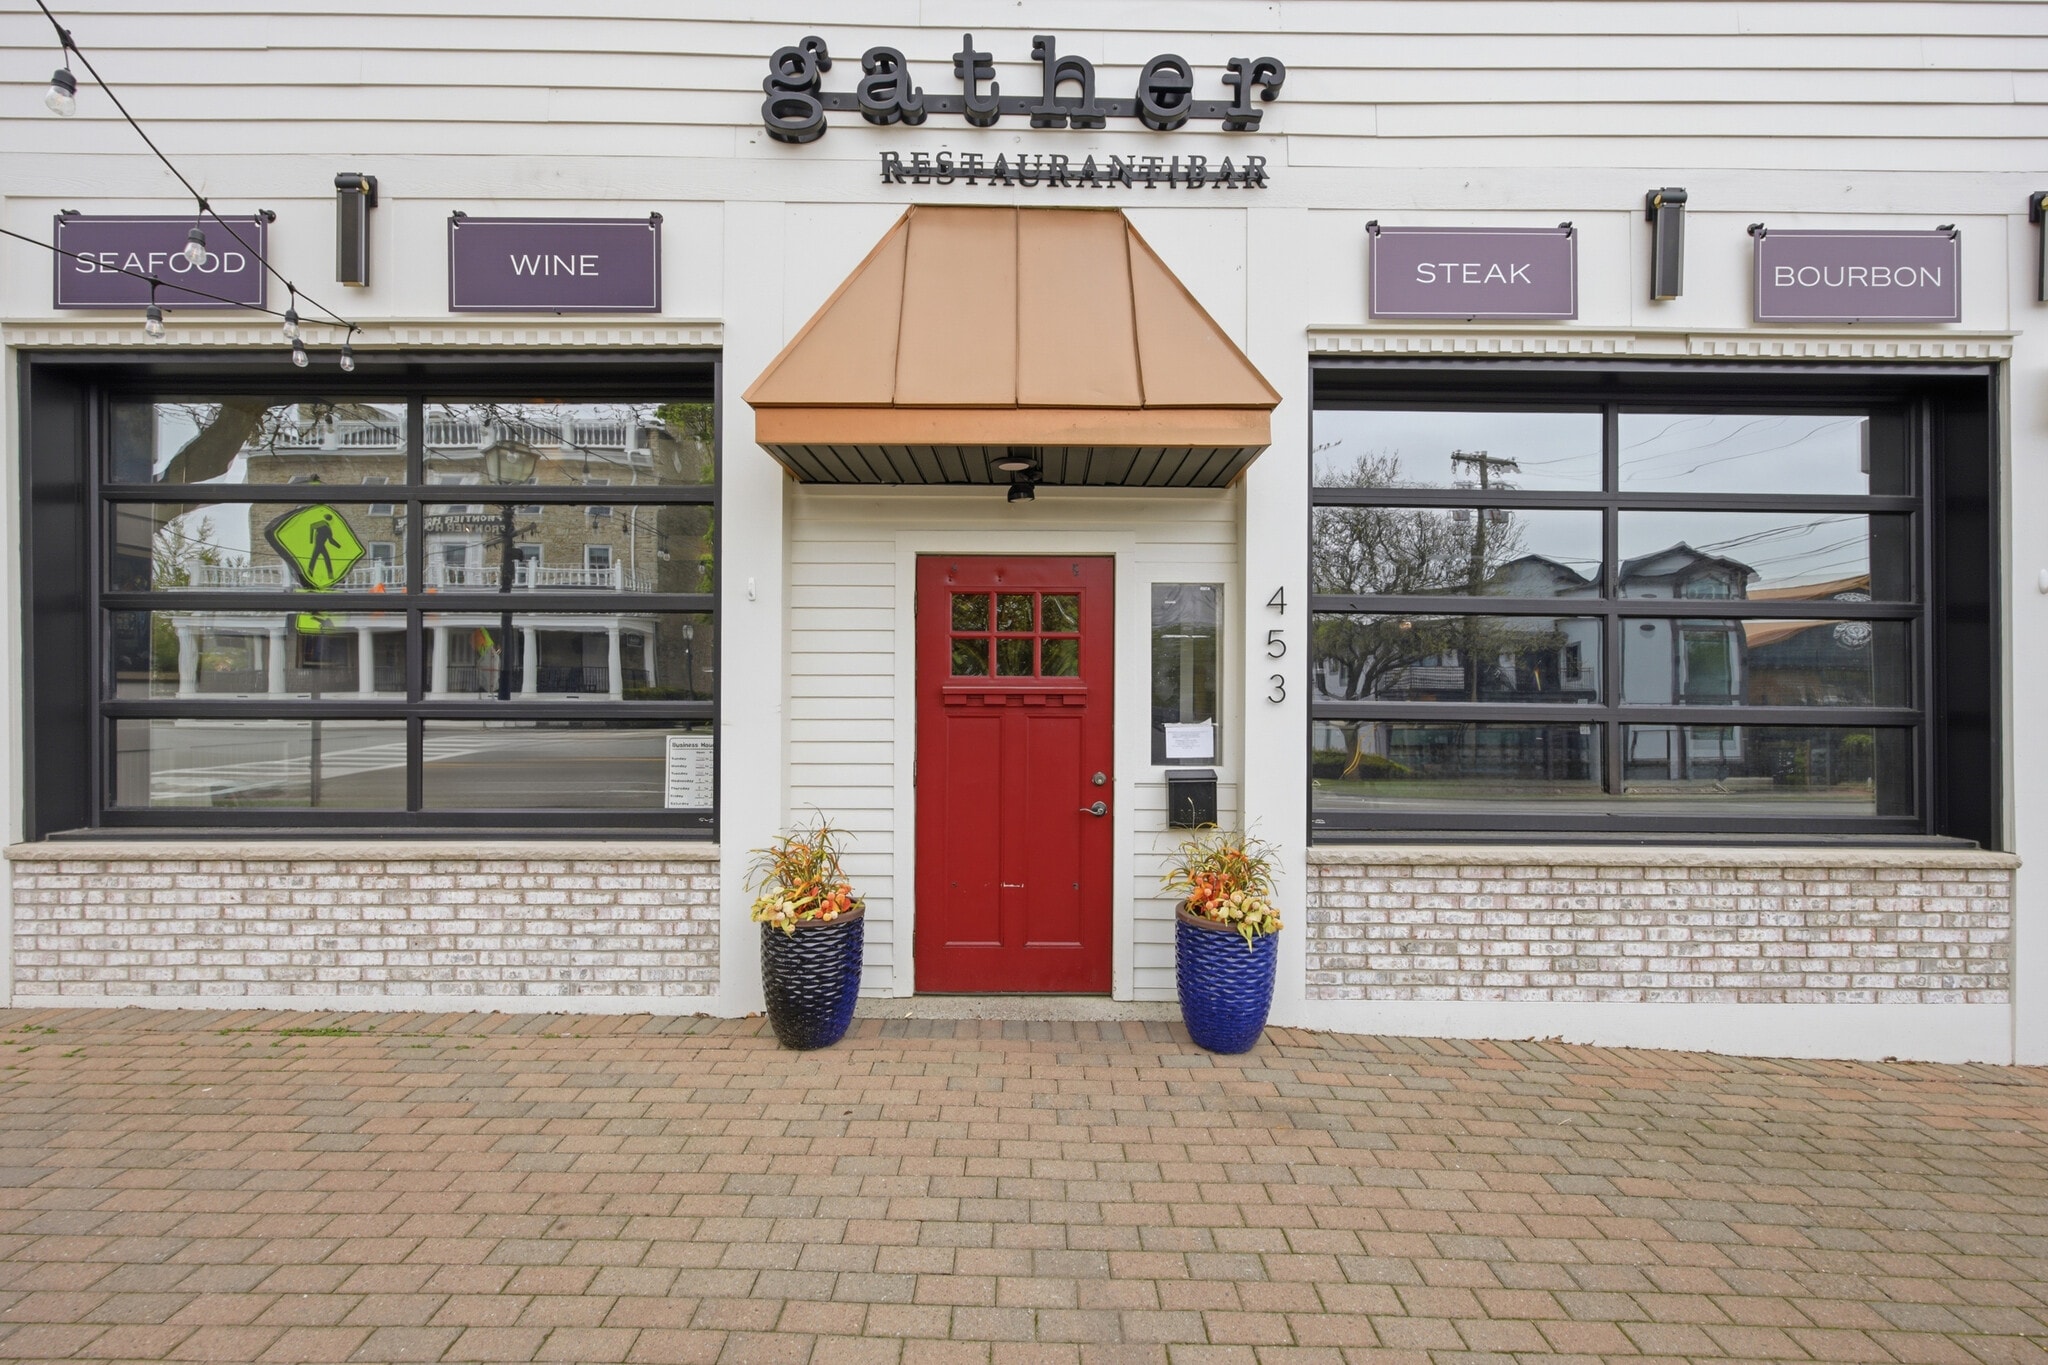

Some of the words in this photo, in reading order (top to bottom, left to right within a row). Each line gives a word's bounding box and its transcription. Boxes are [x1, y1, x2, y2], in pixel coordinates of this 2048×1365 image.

[761, 32, 1286, 140] gather
[75, 252, 246, 274] SEAFOOD
[509, 254, 599, 276] WINE
[1416, 262, 1531, 284] STEAK
[1774, 265, 1941, 287] BOURBON
